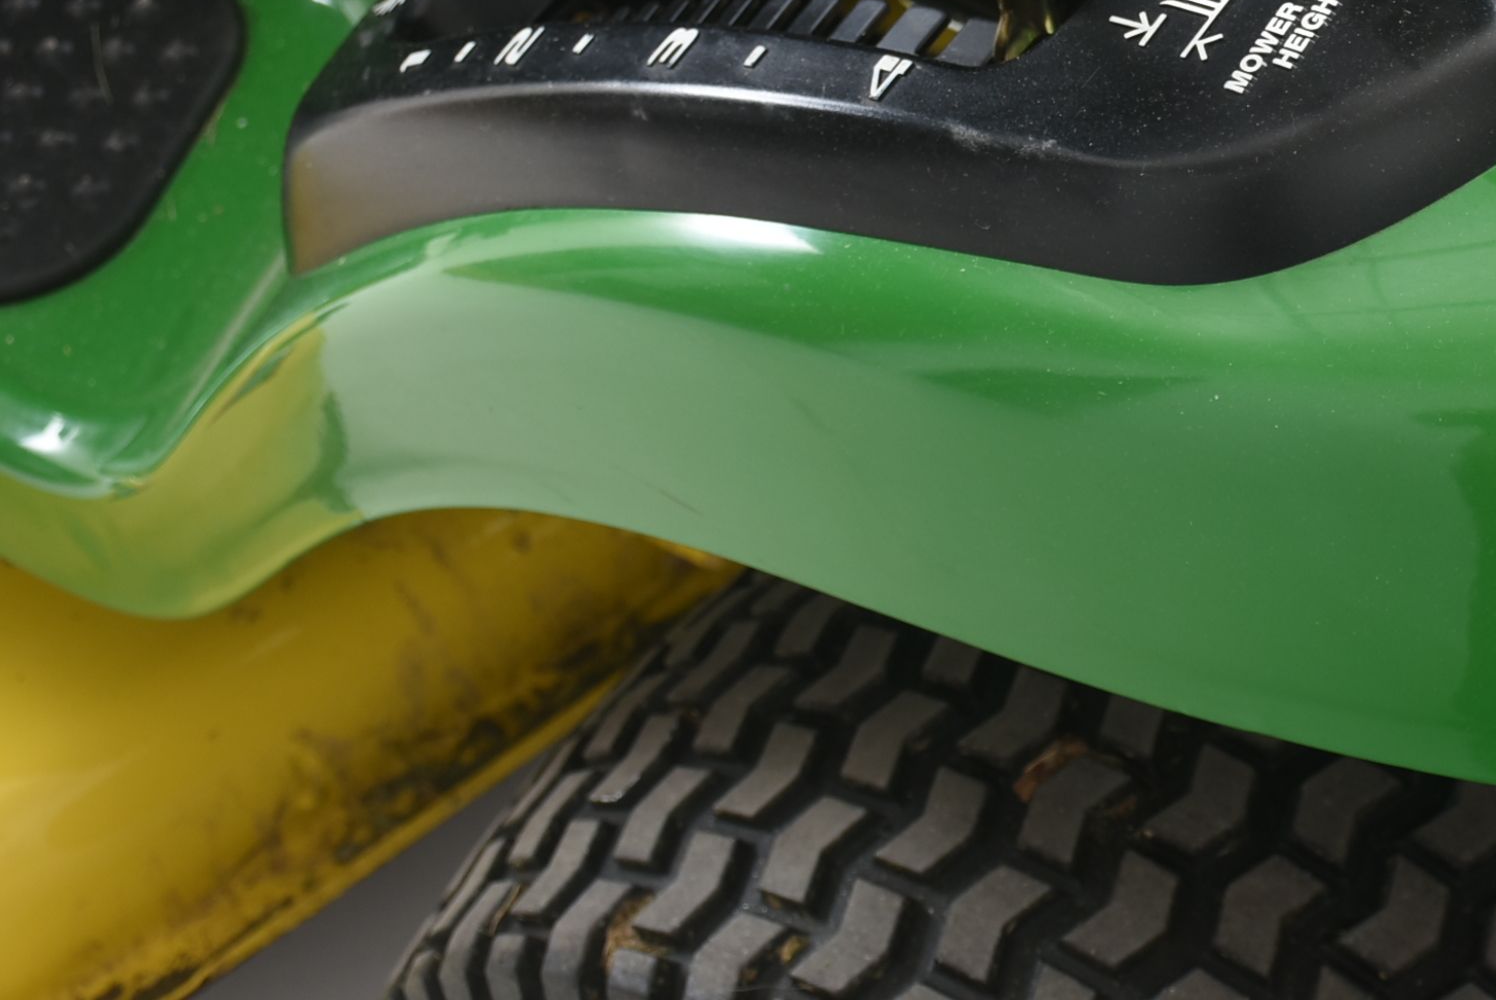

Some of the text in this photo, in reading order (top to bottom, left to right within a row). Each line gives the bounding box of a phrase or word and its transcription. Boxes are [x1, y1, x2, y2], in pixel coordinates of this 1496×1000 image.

[646, 28, 699, 67] 3
[1223, 2, 1305, 94] MOWER
[869, 53, 914, 101] 4
